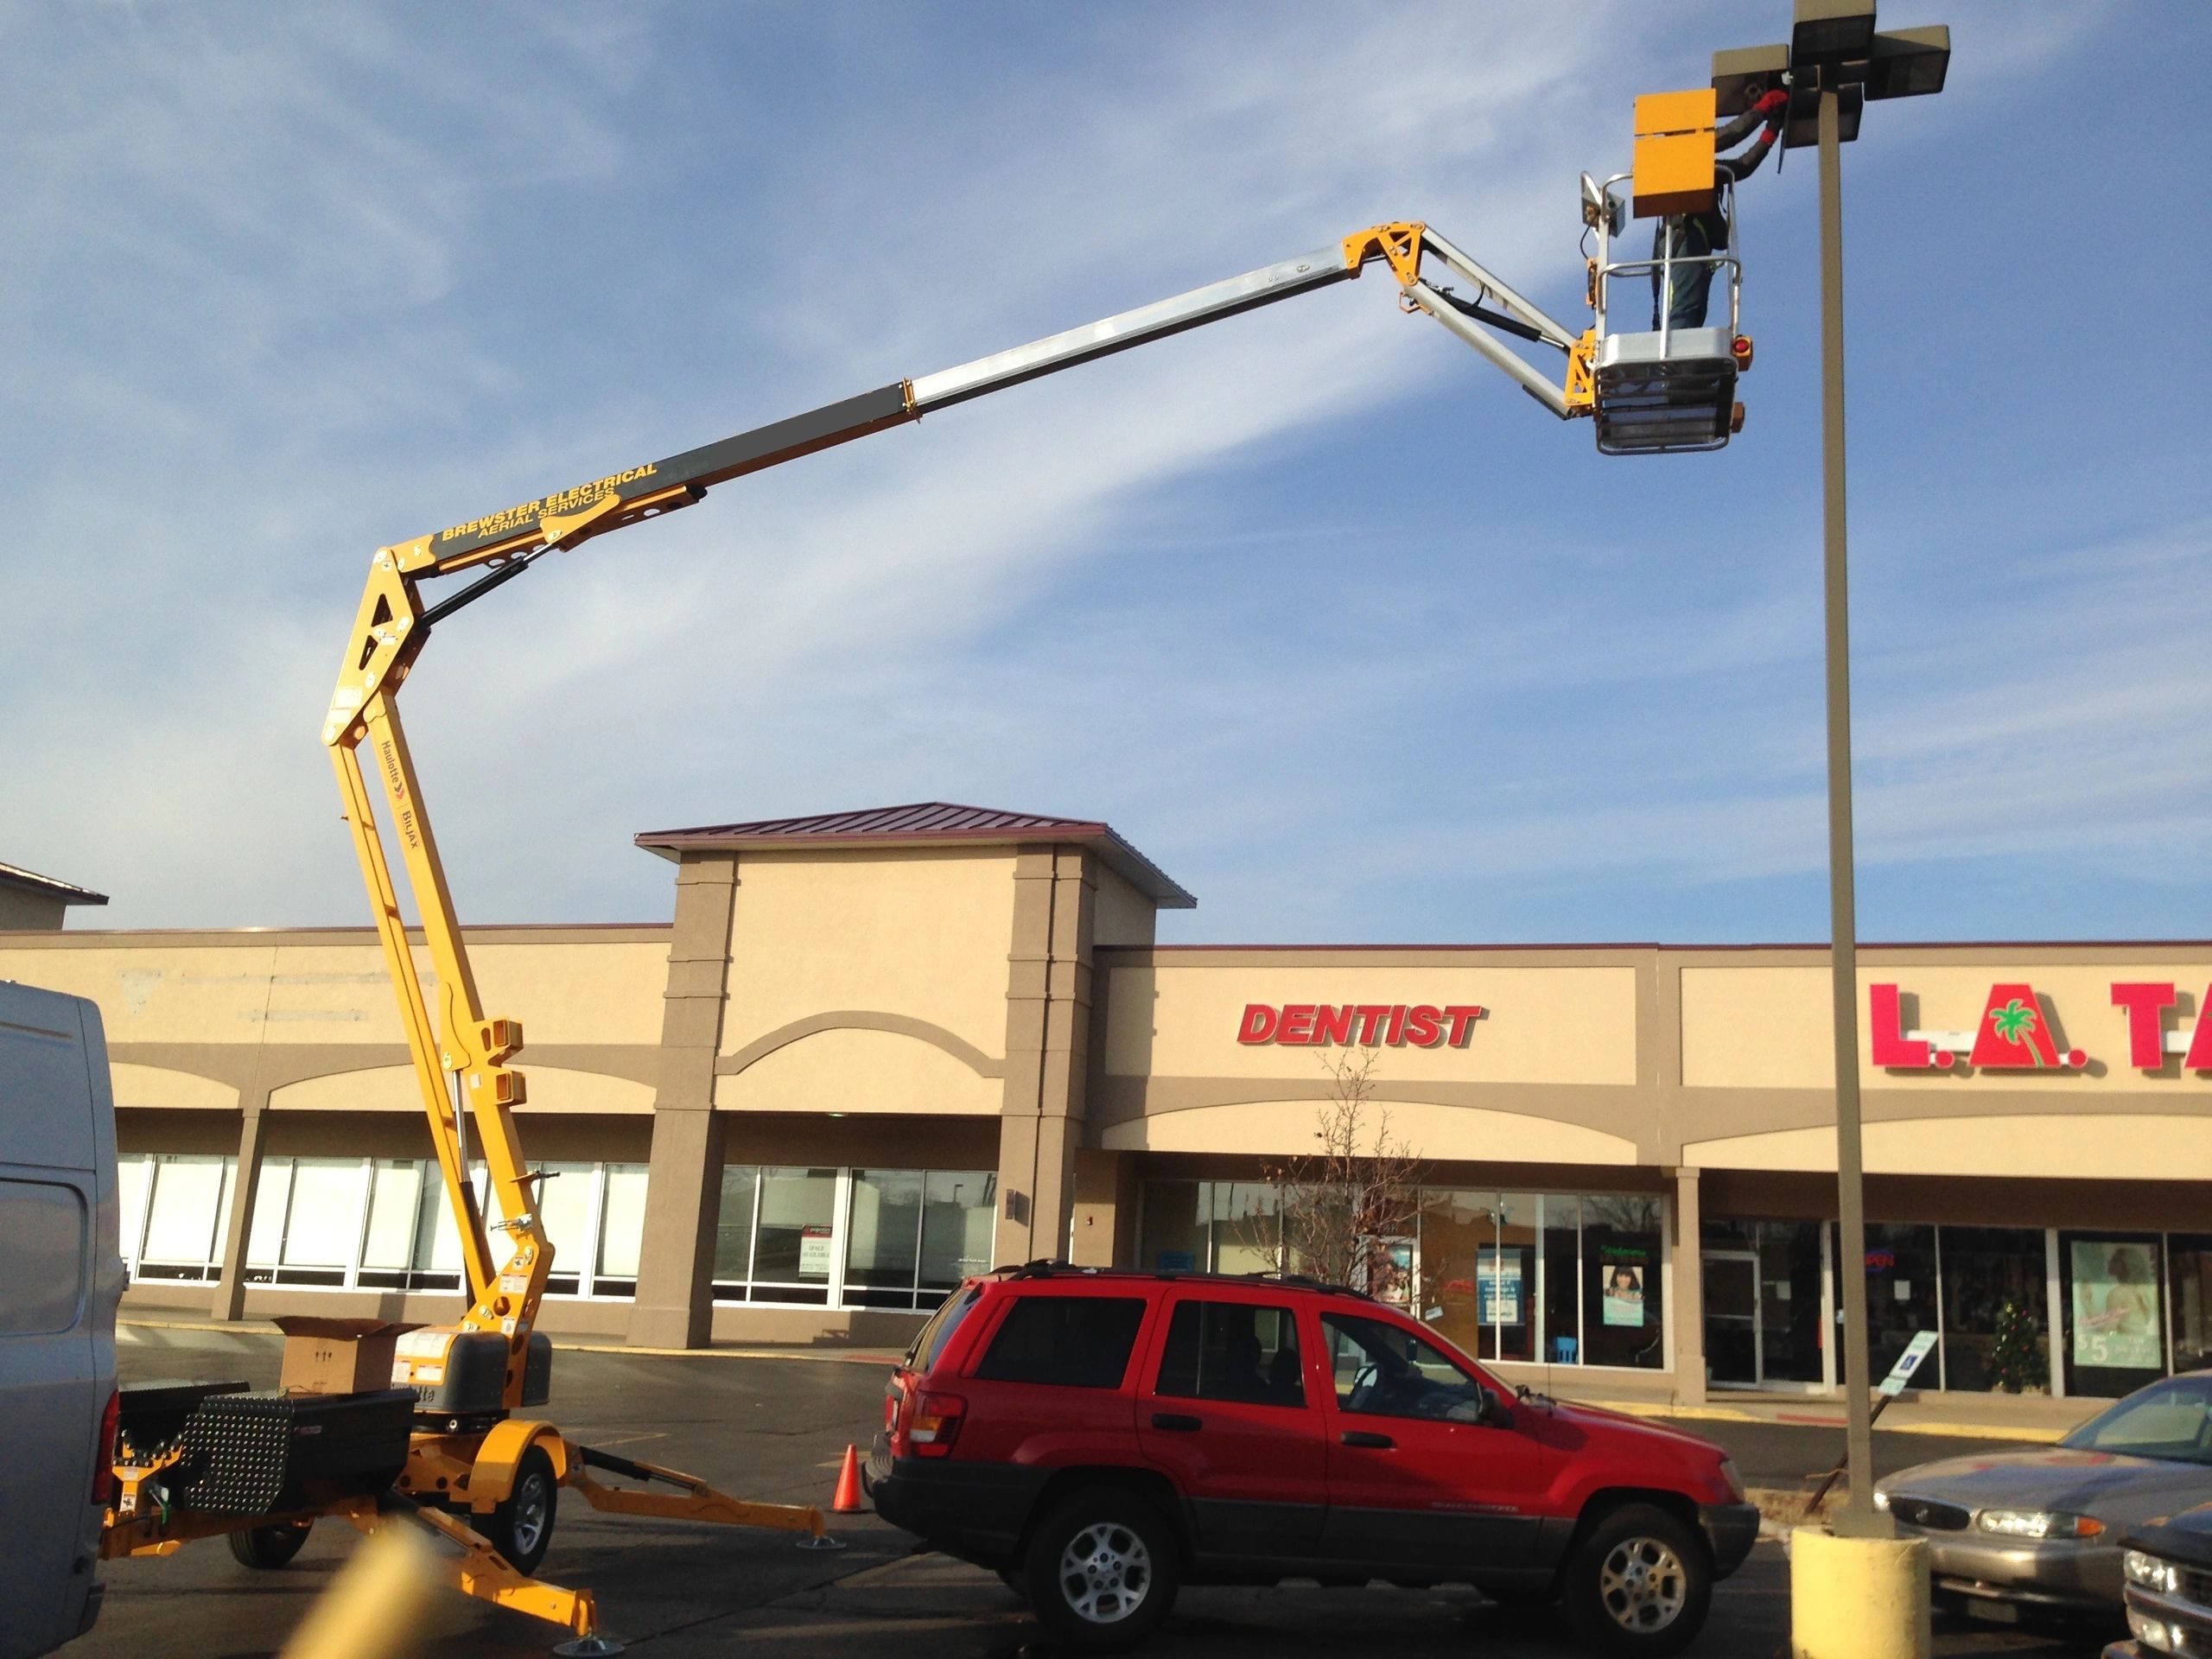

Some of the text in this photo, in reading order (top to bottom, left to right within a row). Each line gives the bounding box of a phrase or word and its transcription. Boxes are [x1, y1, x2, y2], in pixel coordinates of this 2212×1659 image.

[442, 463, 658, 542] BREWSTER ELECTRICAL
[477, 487, 615, 539] AERIAL SERVICES
[382, 741, 399, 783] Haulotte
[1236, 1003, 1482, 1046] DENTIST
